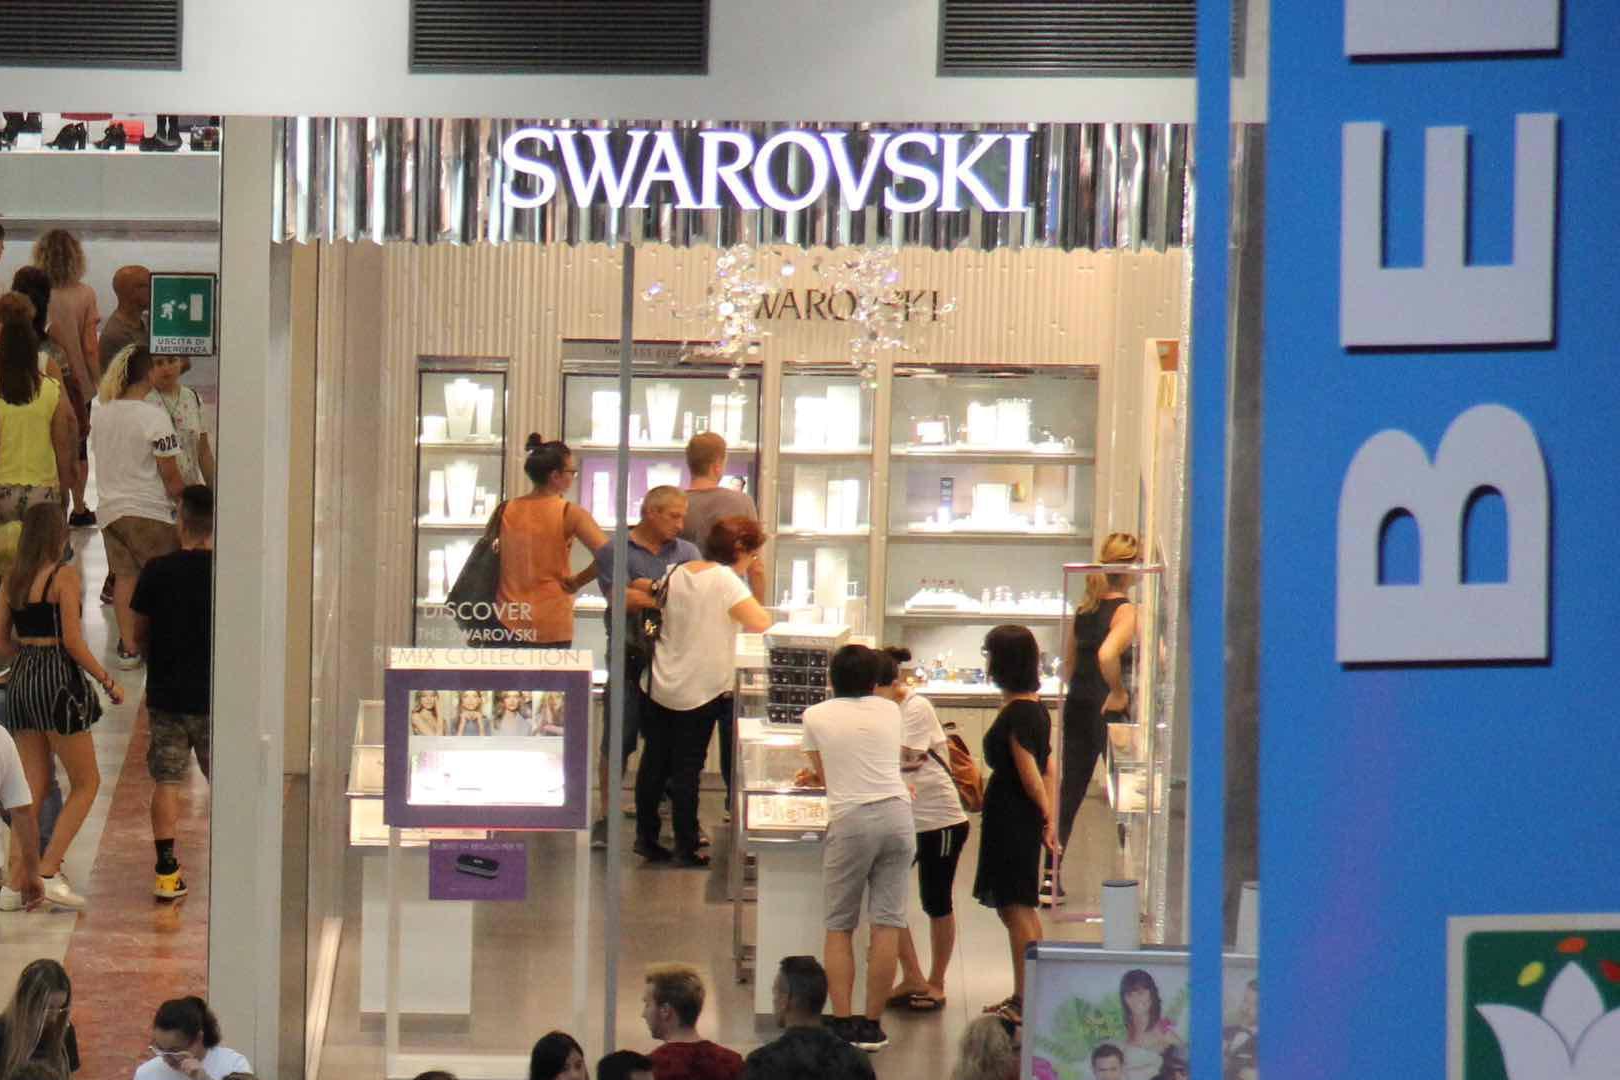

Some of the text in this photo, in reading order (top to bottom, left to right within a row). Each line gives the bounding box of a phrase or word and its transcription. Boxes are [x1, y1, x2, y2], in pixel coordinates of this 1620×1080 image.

[501, 128, 1035, 213] SWAROVSKI
[1335, 0, 1560, 663] BE
[155, 345, 207, 353] EMERGENZA
[156, 337, 205, 345] USCITA DI
[422, 601, 533, 621] DISCOVER
[450, 628, 538, 642] SWAROVSKI
[445, 648, 580, 666] COLLECTION
